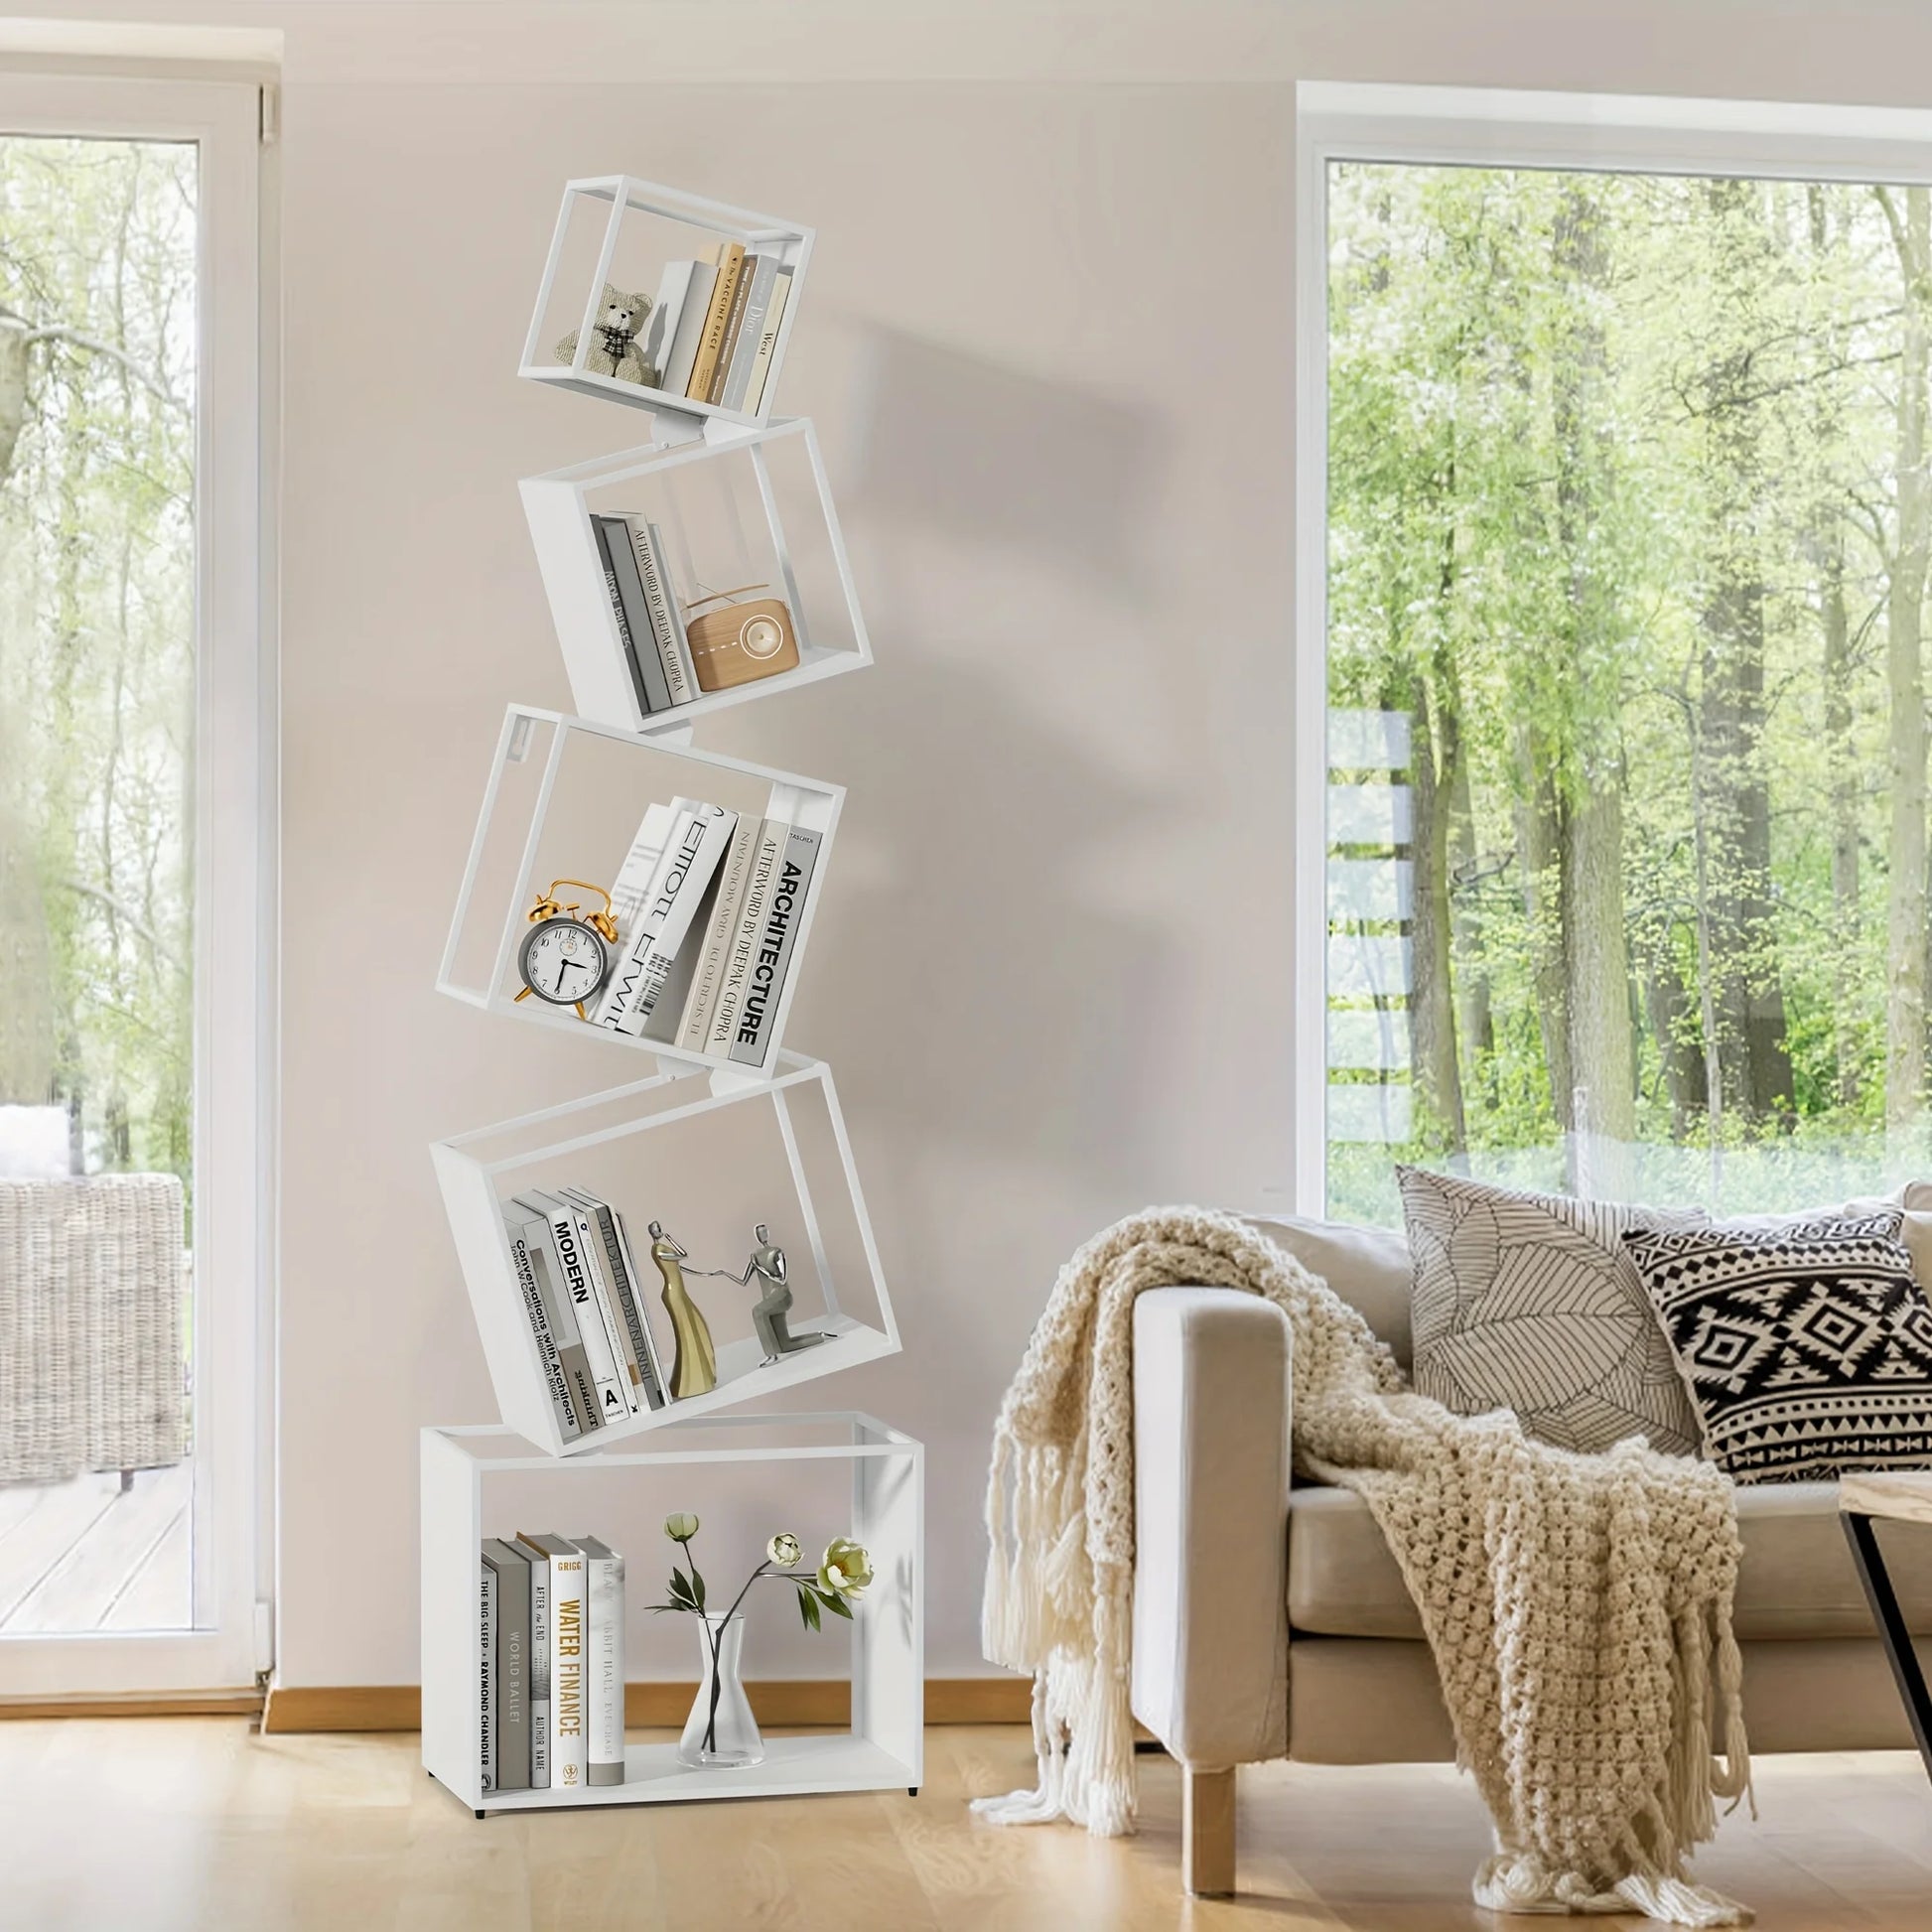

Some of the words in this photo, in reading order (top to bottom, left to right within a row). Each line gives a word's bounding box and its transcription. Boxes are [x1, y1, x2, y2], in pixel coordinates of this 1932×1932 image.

[717, 278, 733, 320] VACCINE
[709, 325, 721, 349] RACE
[745, 305, 763, 336] Dior
[759, 333, 773, 355] West
[633, 529, 659, 593] AFTERWORD
[605, 570, 620, 608] MOON
[615, 607, 631, 649] PHASES
[651, 593, 664, 609] BY
[655, 611, 673, 649] DEEPAK
[666, 650, 684, 692] CHOPRA
[715, 905, 731, 939] GRAY
[725, 831, 750, 903] MOUNTAIN
[744, 837, 776, 917] AFTERWORD
[540, 937, 550, 947] 10
[554, 930, 562, 939] 11
[567, 929, 578, 939] 12
[741, 919, 757, 937] BY
[532, 950, 538, 960] 9
[591, 949, 598, 959] 2
[591, 965, 598, 974] 3
[727, 939, 752, 989] DEEPAK
[737, 861, 802, 1045] ARCHITECTURE
[714, 991, 738, 1042] CHOPRA
[554, 1221, 589, 1304] MODERN
[516, 1239, 547, 1330] Conversations
[543, 1332, 556, 1359] with
[552, 1363, 575, 1426] Architects
[528, 1311, 541, 1332] and
[536, 1334, 552, 1376] Heinrich
[548, 1378, 559, 1401] Klotz
[606, 1389, 619, 1407] A
[558, 1562, 582, 1571] GRIGG
[536, 1587, 545, 1609] AFTER
[536, 1625, 545, 1641] END
[559, 1599, 580, 1656] WATER
[509, 1631, 520, 1676] WORLD
[509, 1681, 519, 1723] BALLET
[559, 1663, 580, 1736] FINANCE
[536, 1717, 545, 1745] AUTHOR
[536, 1749, 545, 1770] NAME
